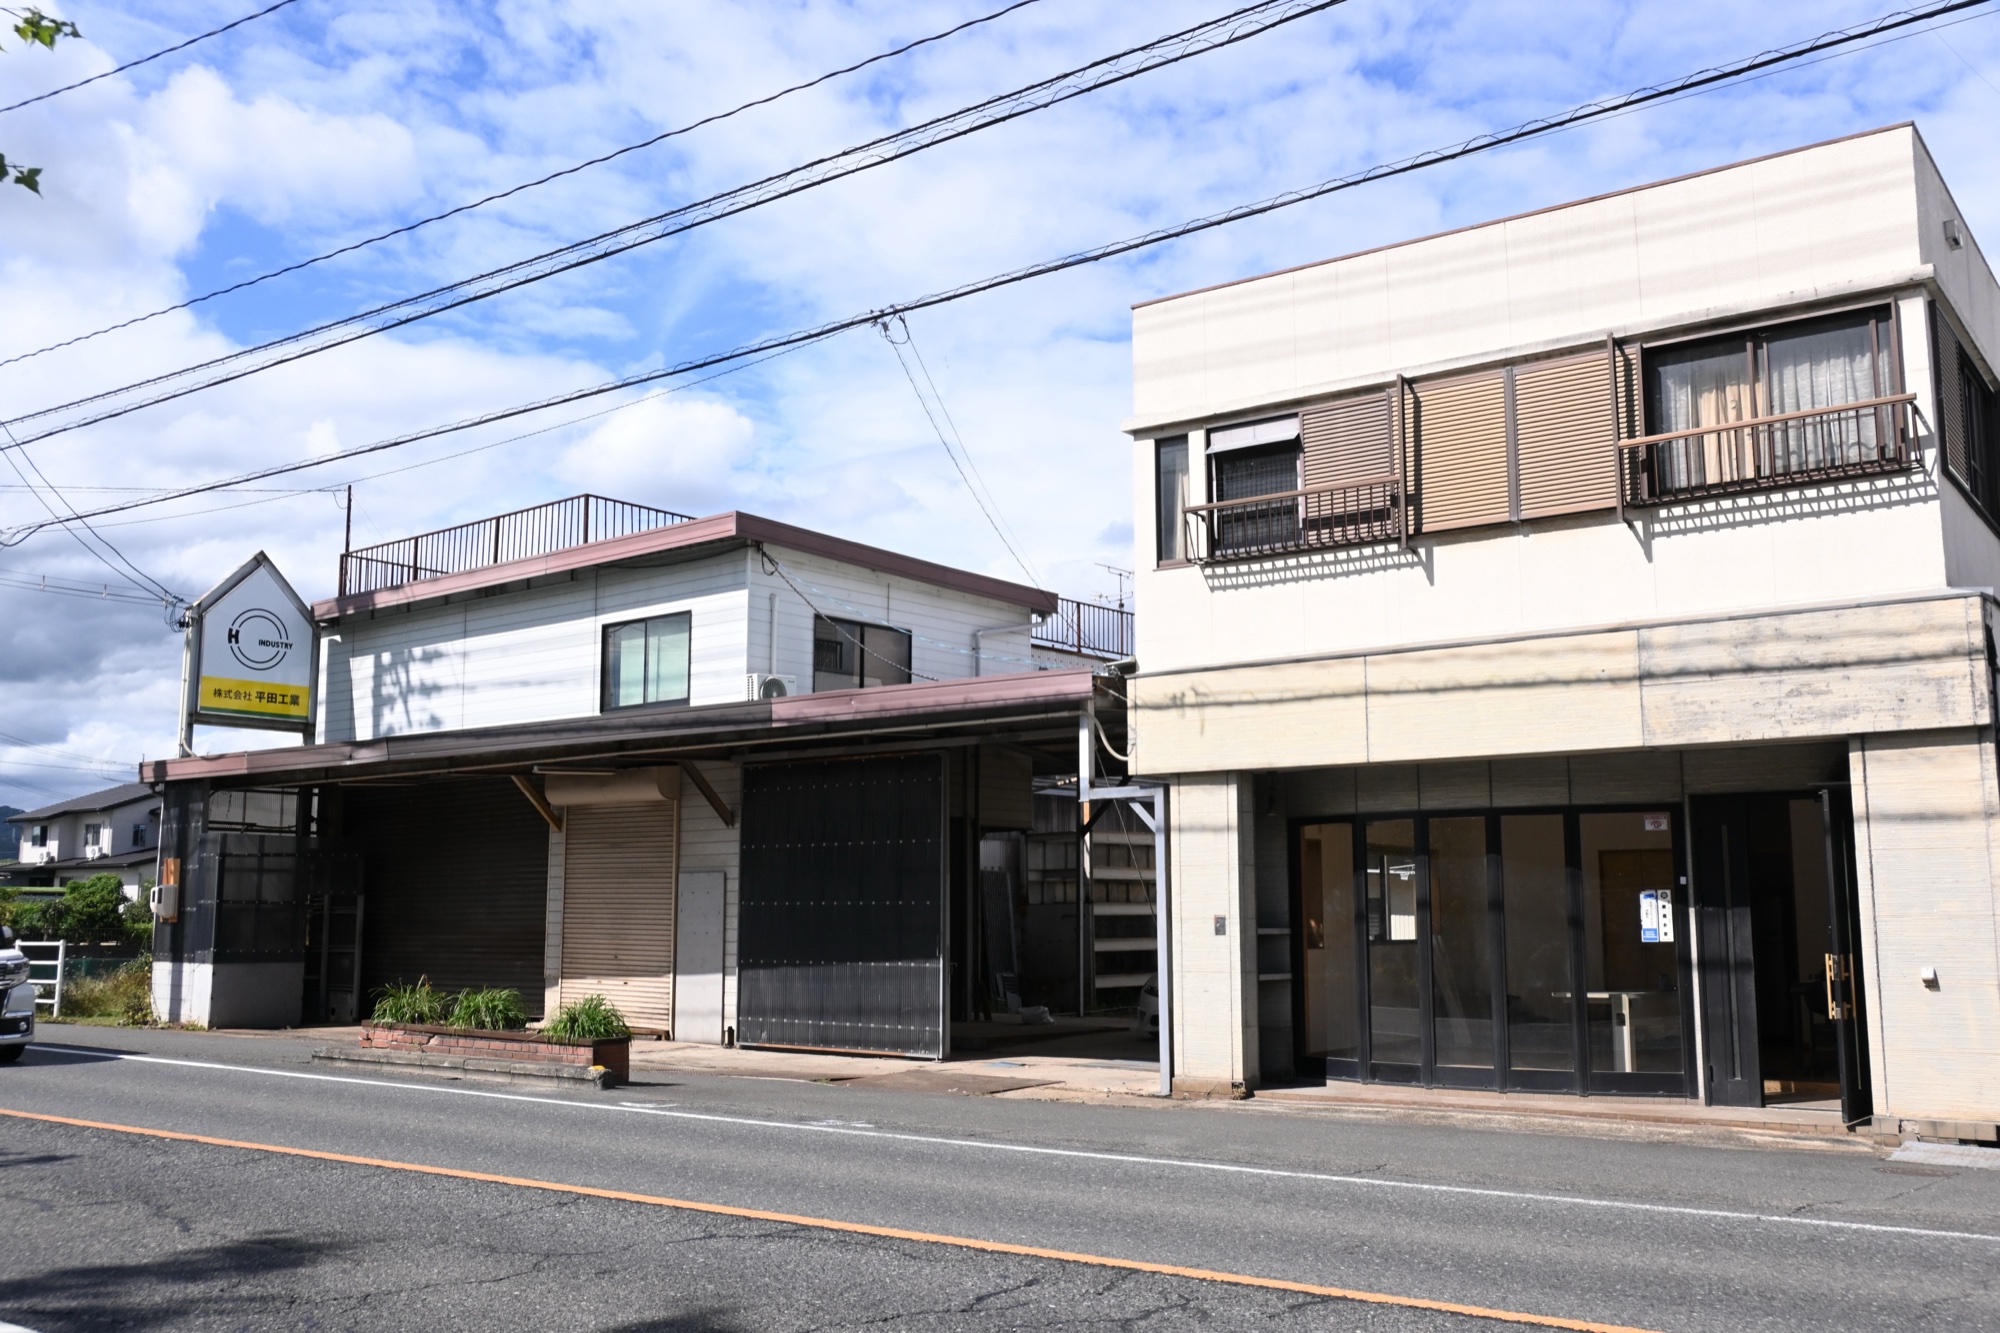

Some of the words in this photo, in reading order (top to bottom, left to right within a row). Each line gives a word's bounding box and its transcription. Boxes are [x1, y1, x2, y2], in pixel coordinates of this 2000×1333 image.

[228, 628, 240, 645] H
[258, 639, 293, 650] INDUSTRY
[213, 688, 253, 701] 株式会社
[255, 691, 300, 706] 平田工業
